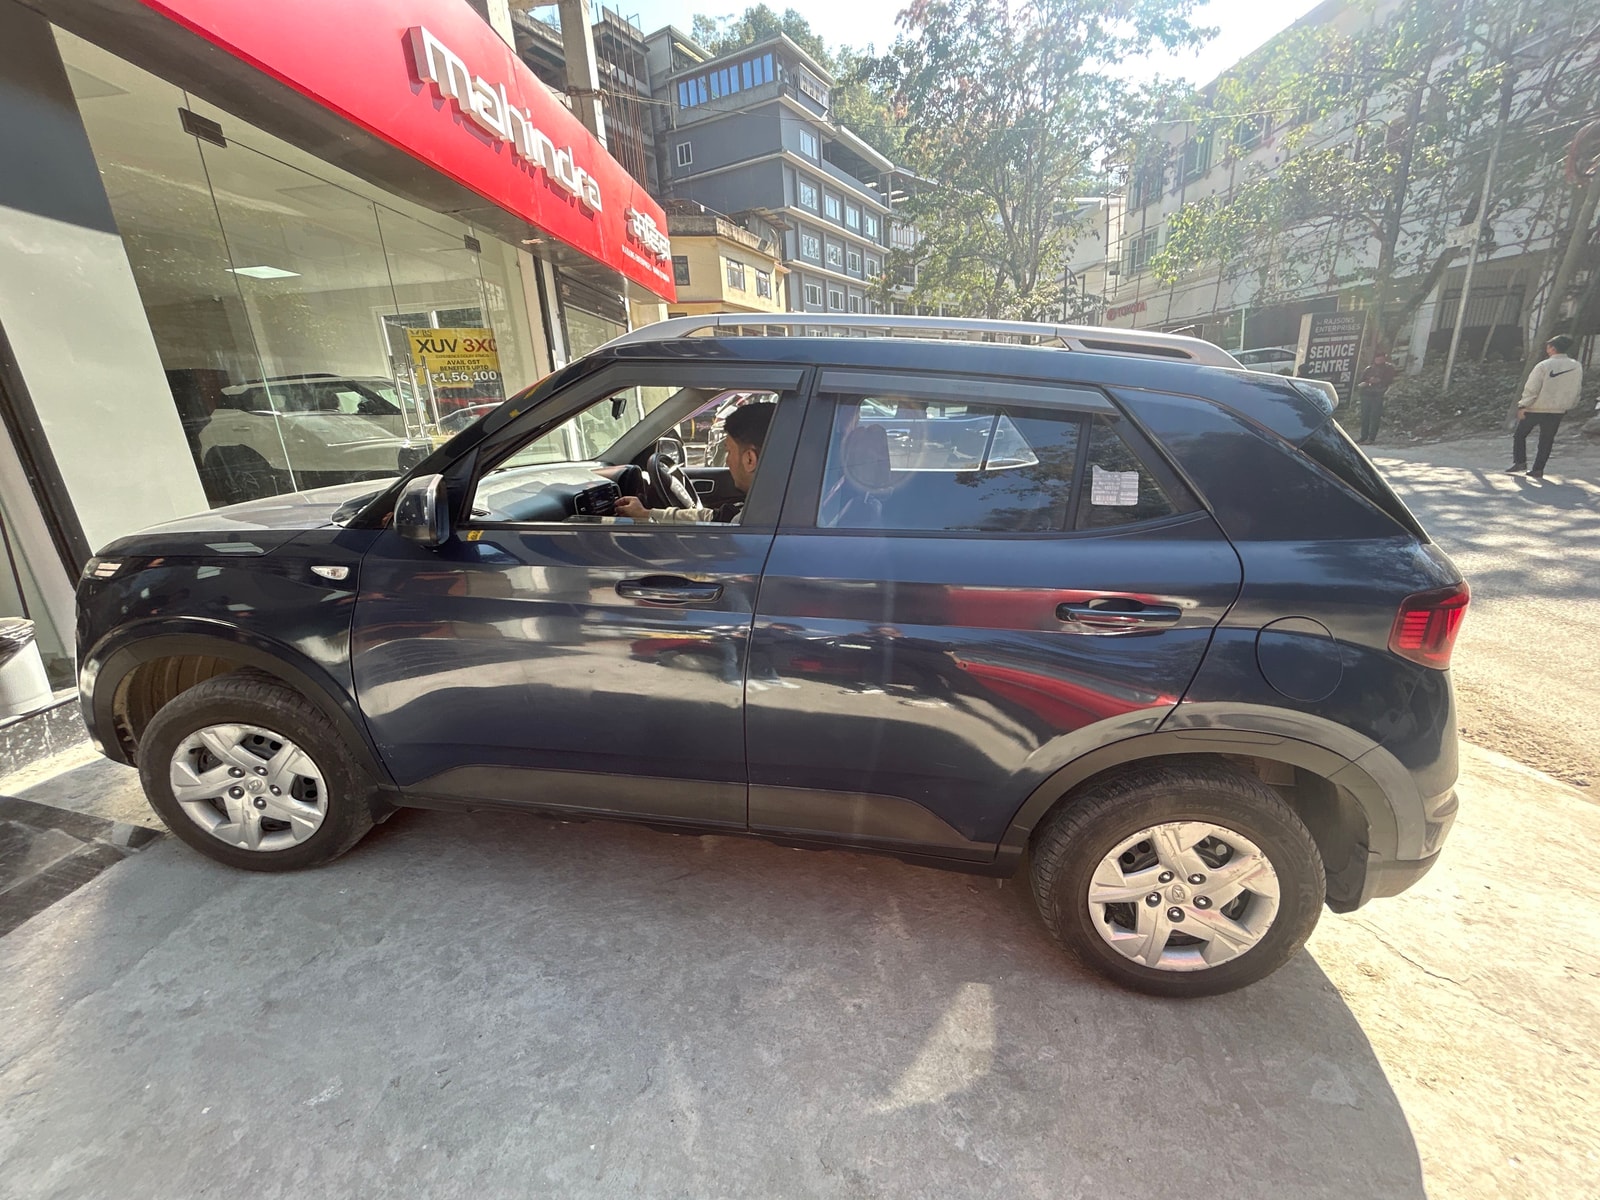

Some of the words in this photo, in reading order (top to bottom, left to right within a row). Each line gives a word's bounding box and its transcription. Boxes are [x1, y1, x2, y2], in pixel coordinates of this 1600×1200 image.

[409, 26, 603, 212] mahindra
[1315, 323, 1361, 333] ENTERPRISES
[1323, 316, 1355, 325] RAJSONS
[416, 338, 458, 353] XUV
[1309, 343, 1356, 359] SERVICE
